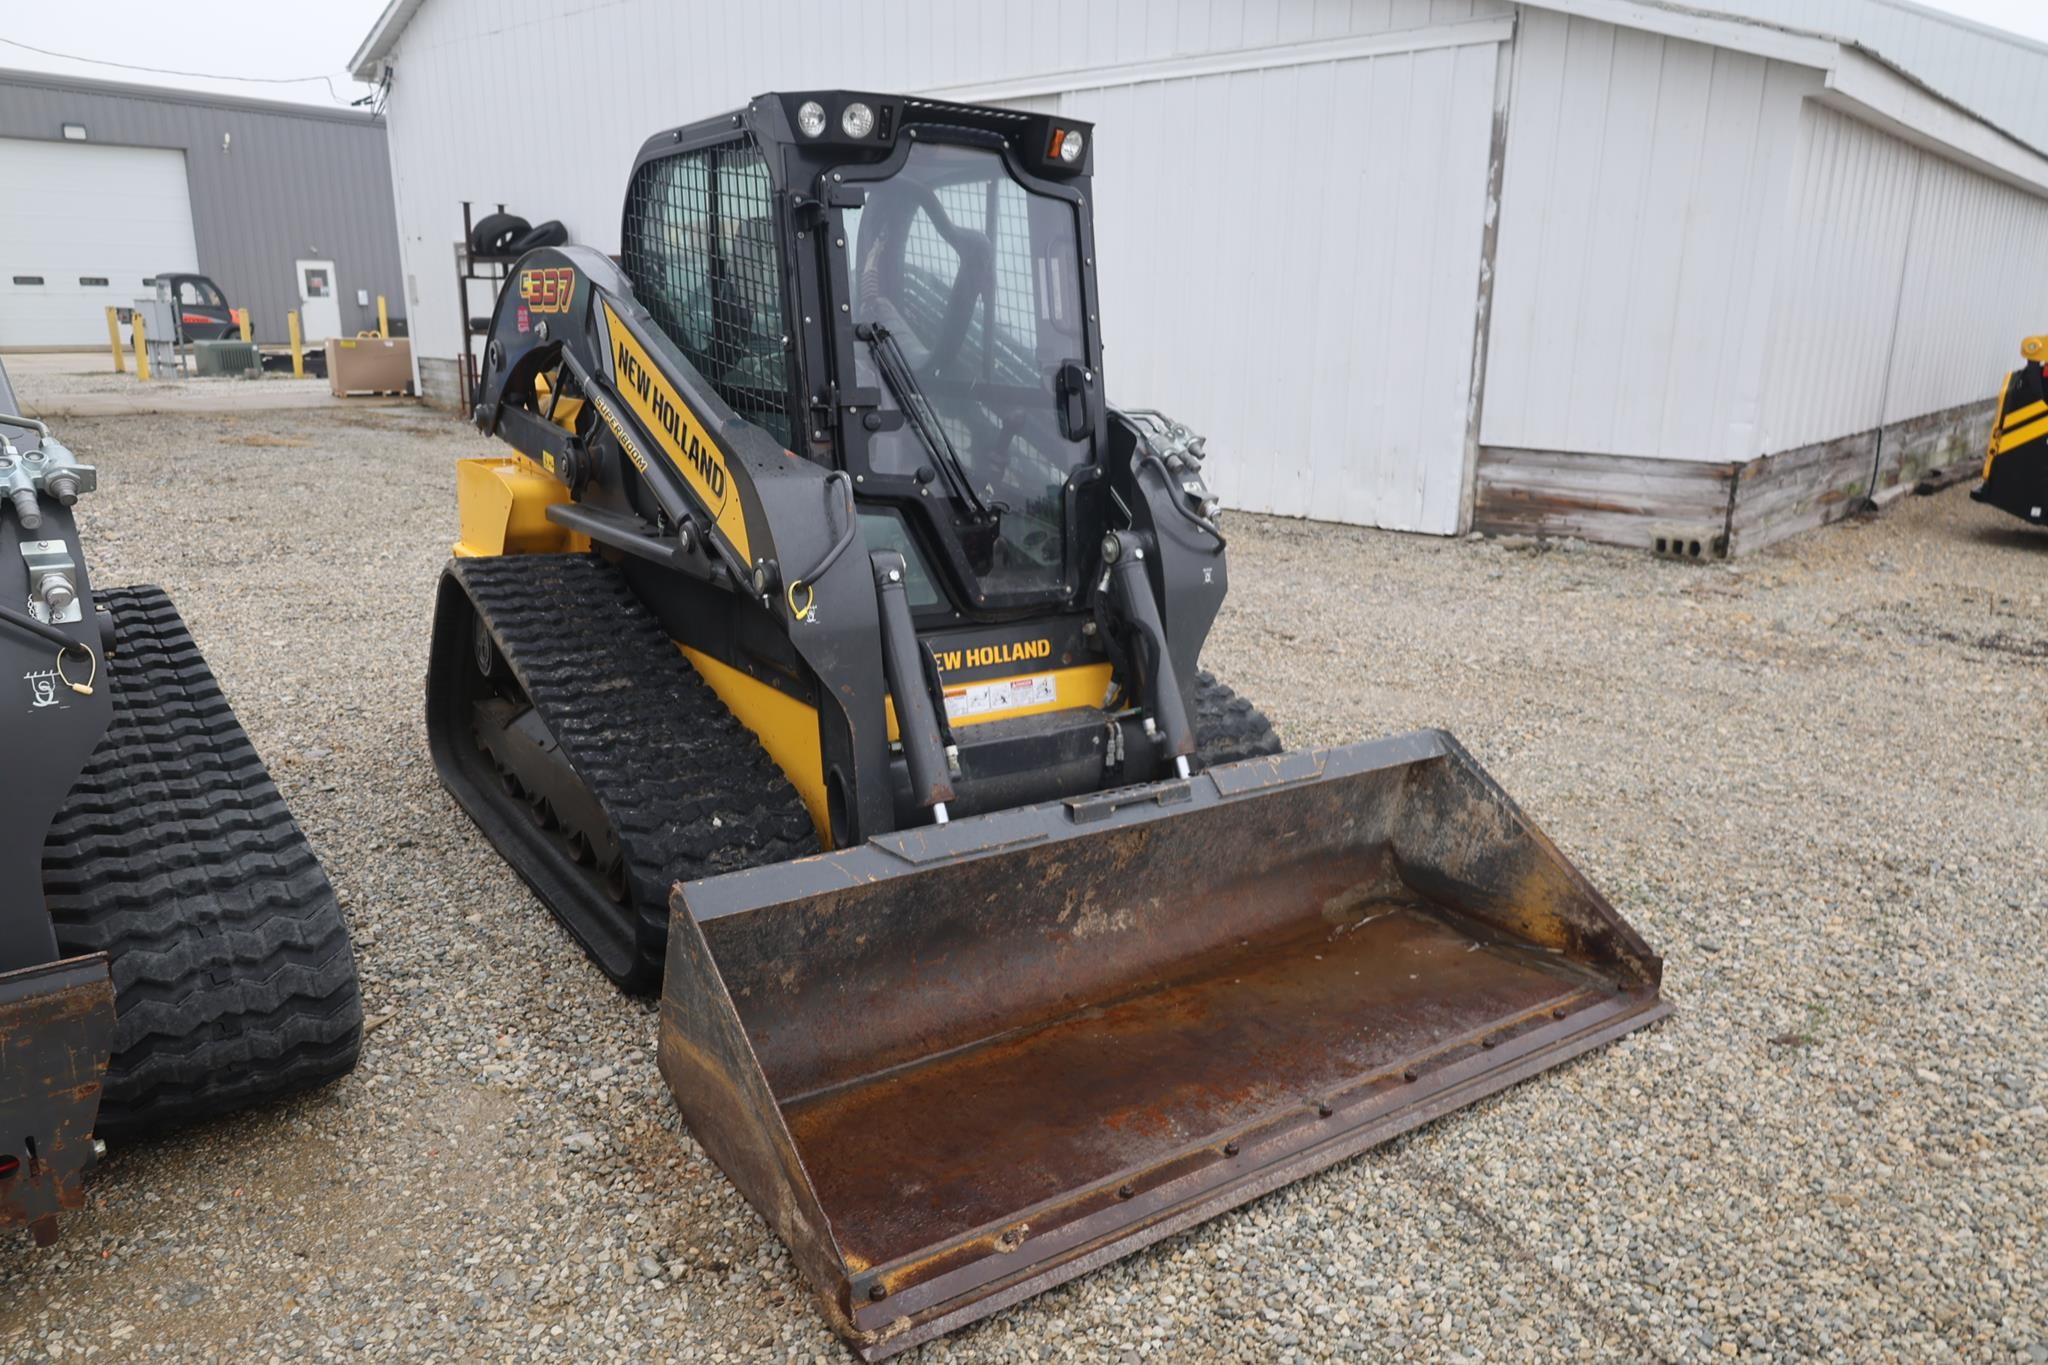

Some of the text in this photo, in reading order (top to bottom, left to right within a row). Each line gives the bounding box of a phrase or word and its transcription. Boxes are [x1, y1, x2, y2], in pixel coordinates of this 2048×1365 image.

[595, 396, 648, 473] SUPER BOOM
[618, 340, 725, 498] NEW HOLLAND
[934, 639, 1051, 671] EW HOLLAND
